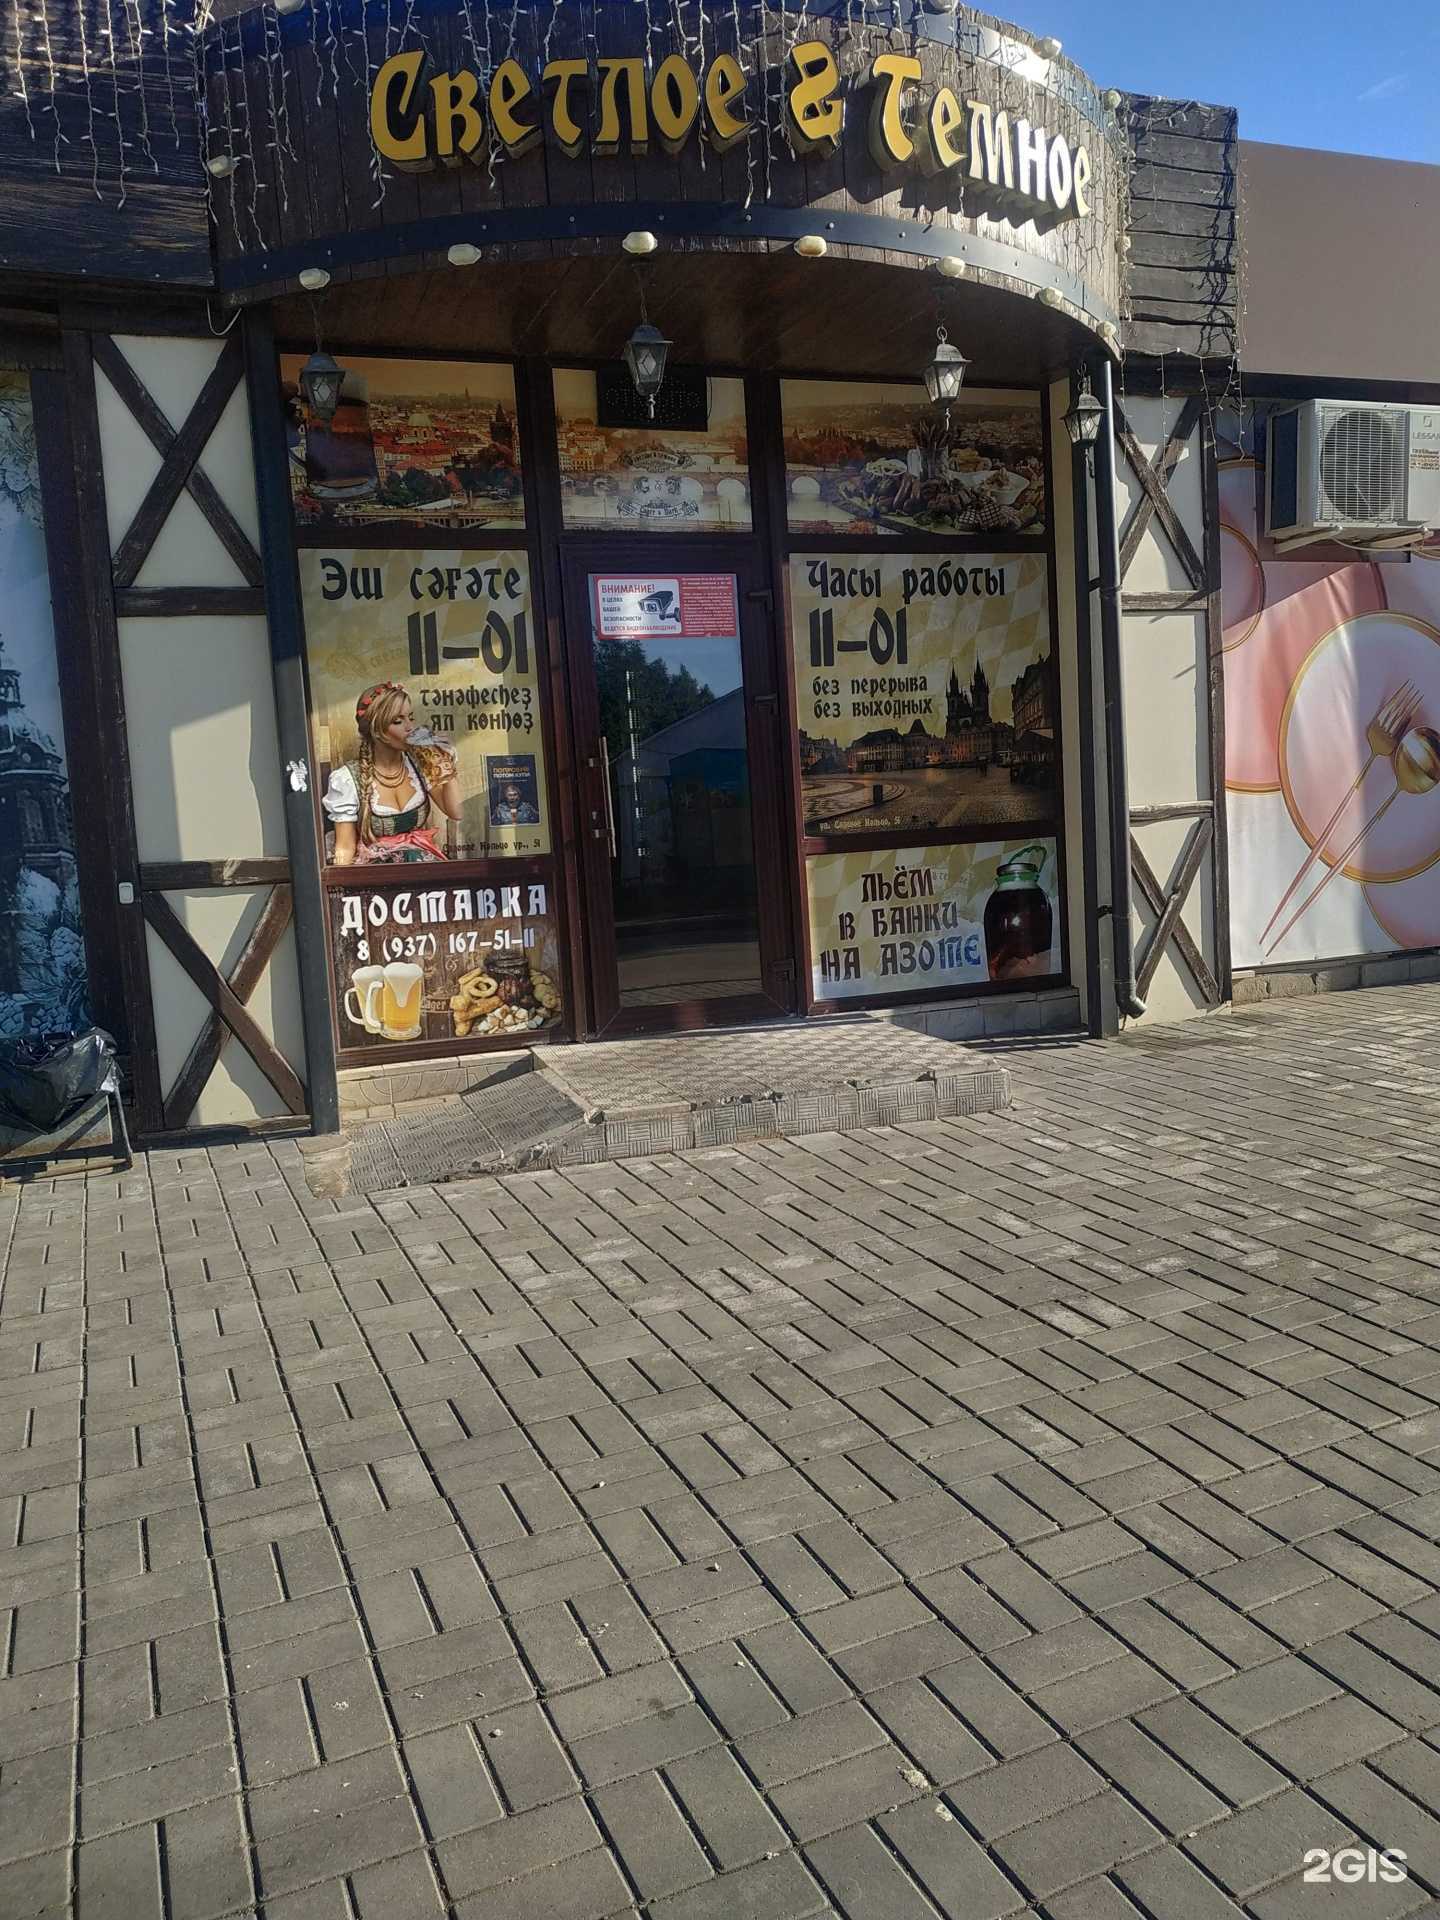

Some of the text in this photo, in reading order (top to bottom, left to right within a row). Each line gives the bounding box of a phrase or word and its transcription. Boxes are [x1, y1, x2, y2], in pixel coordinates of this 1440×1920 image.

[369, 40, 1091, 218] Светлое & Темное
[319, 557, 523, 600] Эш сәғәте
[601, 584, 655, 593] ВНИМАНИЕ!
[806, 560, 1005, 604] Часы работы
[812, 676, 928, 697] без перерыва
[431, 714, 454, 732] ял
[814, 698, 932, 719] без выходных
[340, 884, 547, 937] ДОСТАВКА
[839, 901, 958, 940] В БАНКИ
[357, 928, 535, 962] 8 (937) 167-51-11
[820, 934, 982, 983] НА АЗОТЕ
